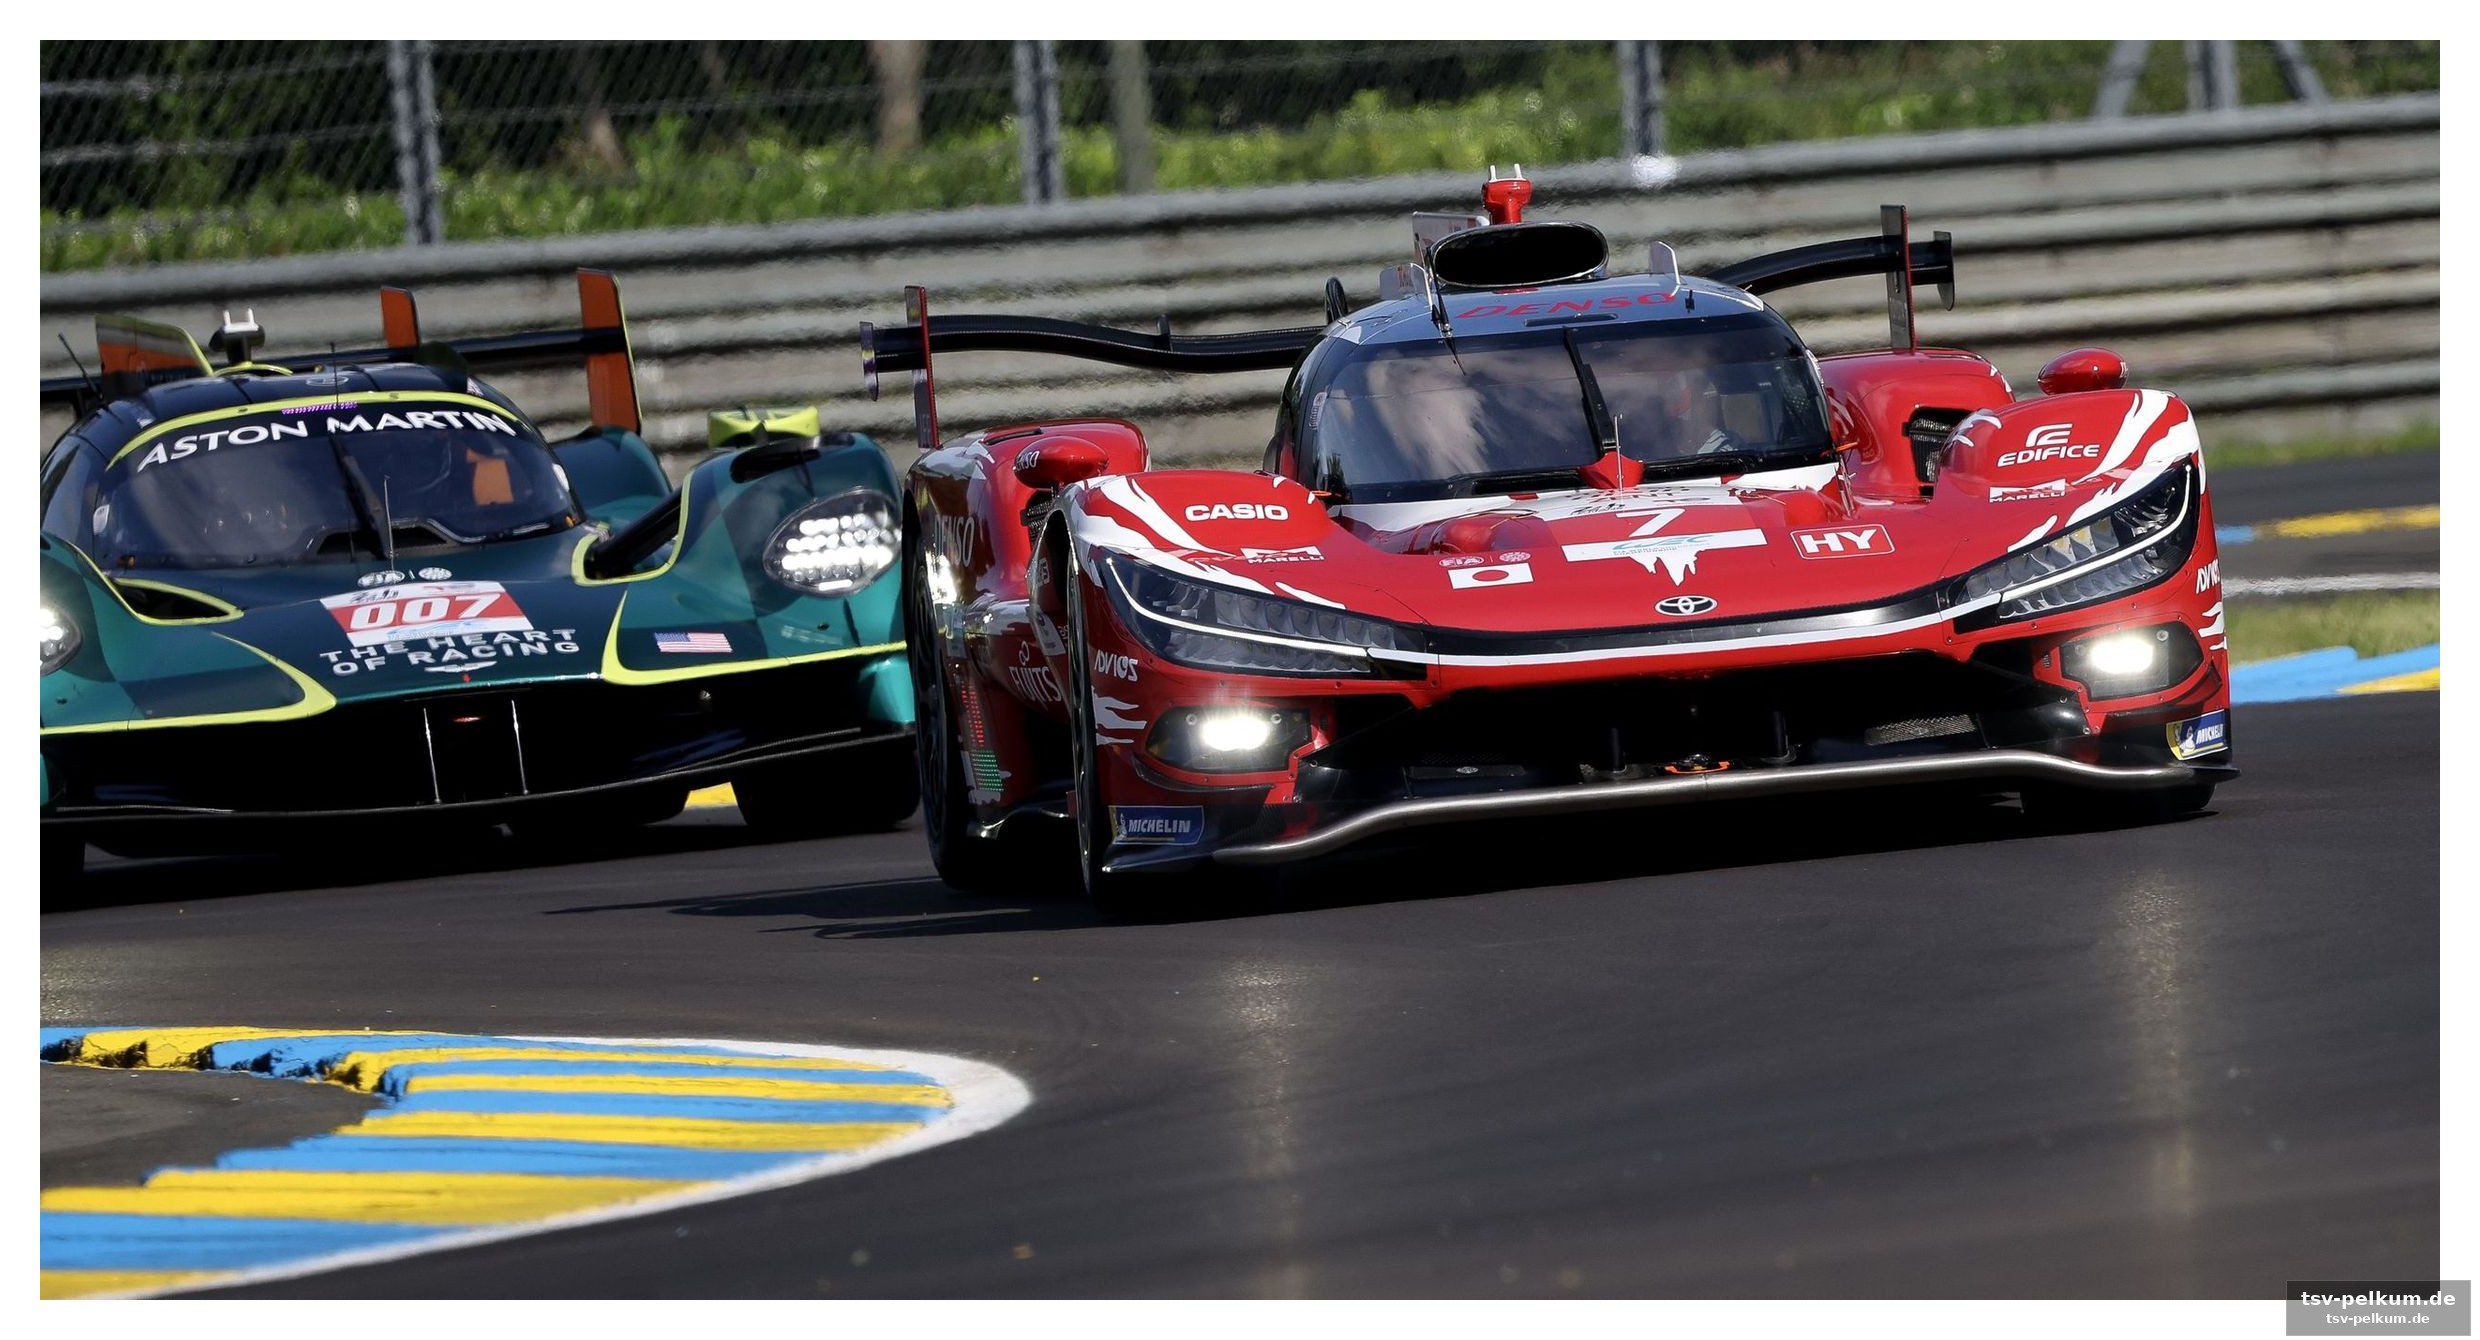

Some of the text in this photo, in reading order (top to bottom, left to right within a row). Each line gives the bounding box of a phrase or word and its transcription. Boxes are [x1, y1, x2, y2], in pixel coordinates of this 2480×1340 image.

[1456, 292, 1676, 319] DENSO
[137, 410, 518, 473] ASTON MARTIN
[1997, 444, 2100, 467] EDIFICE
[1990, 491, 2065, 503] MARELLI
[1184, 503, 1289, 521] CASIO
[1615, 508, 1686, 537] 7
[1799, 529, 1877, 553] HY
[1247, 555, 1325, 564] MARELLI
[350, 593, 501, 630] 007
[320, 641, 410, 663] THE
[427, 629, 576, 650] HEART
[332, 641, 580, 676] OF RACING
[1128, 819, 1191, 833] MICHELIN
